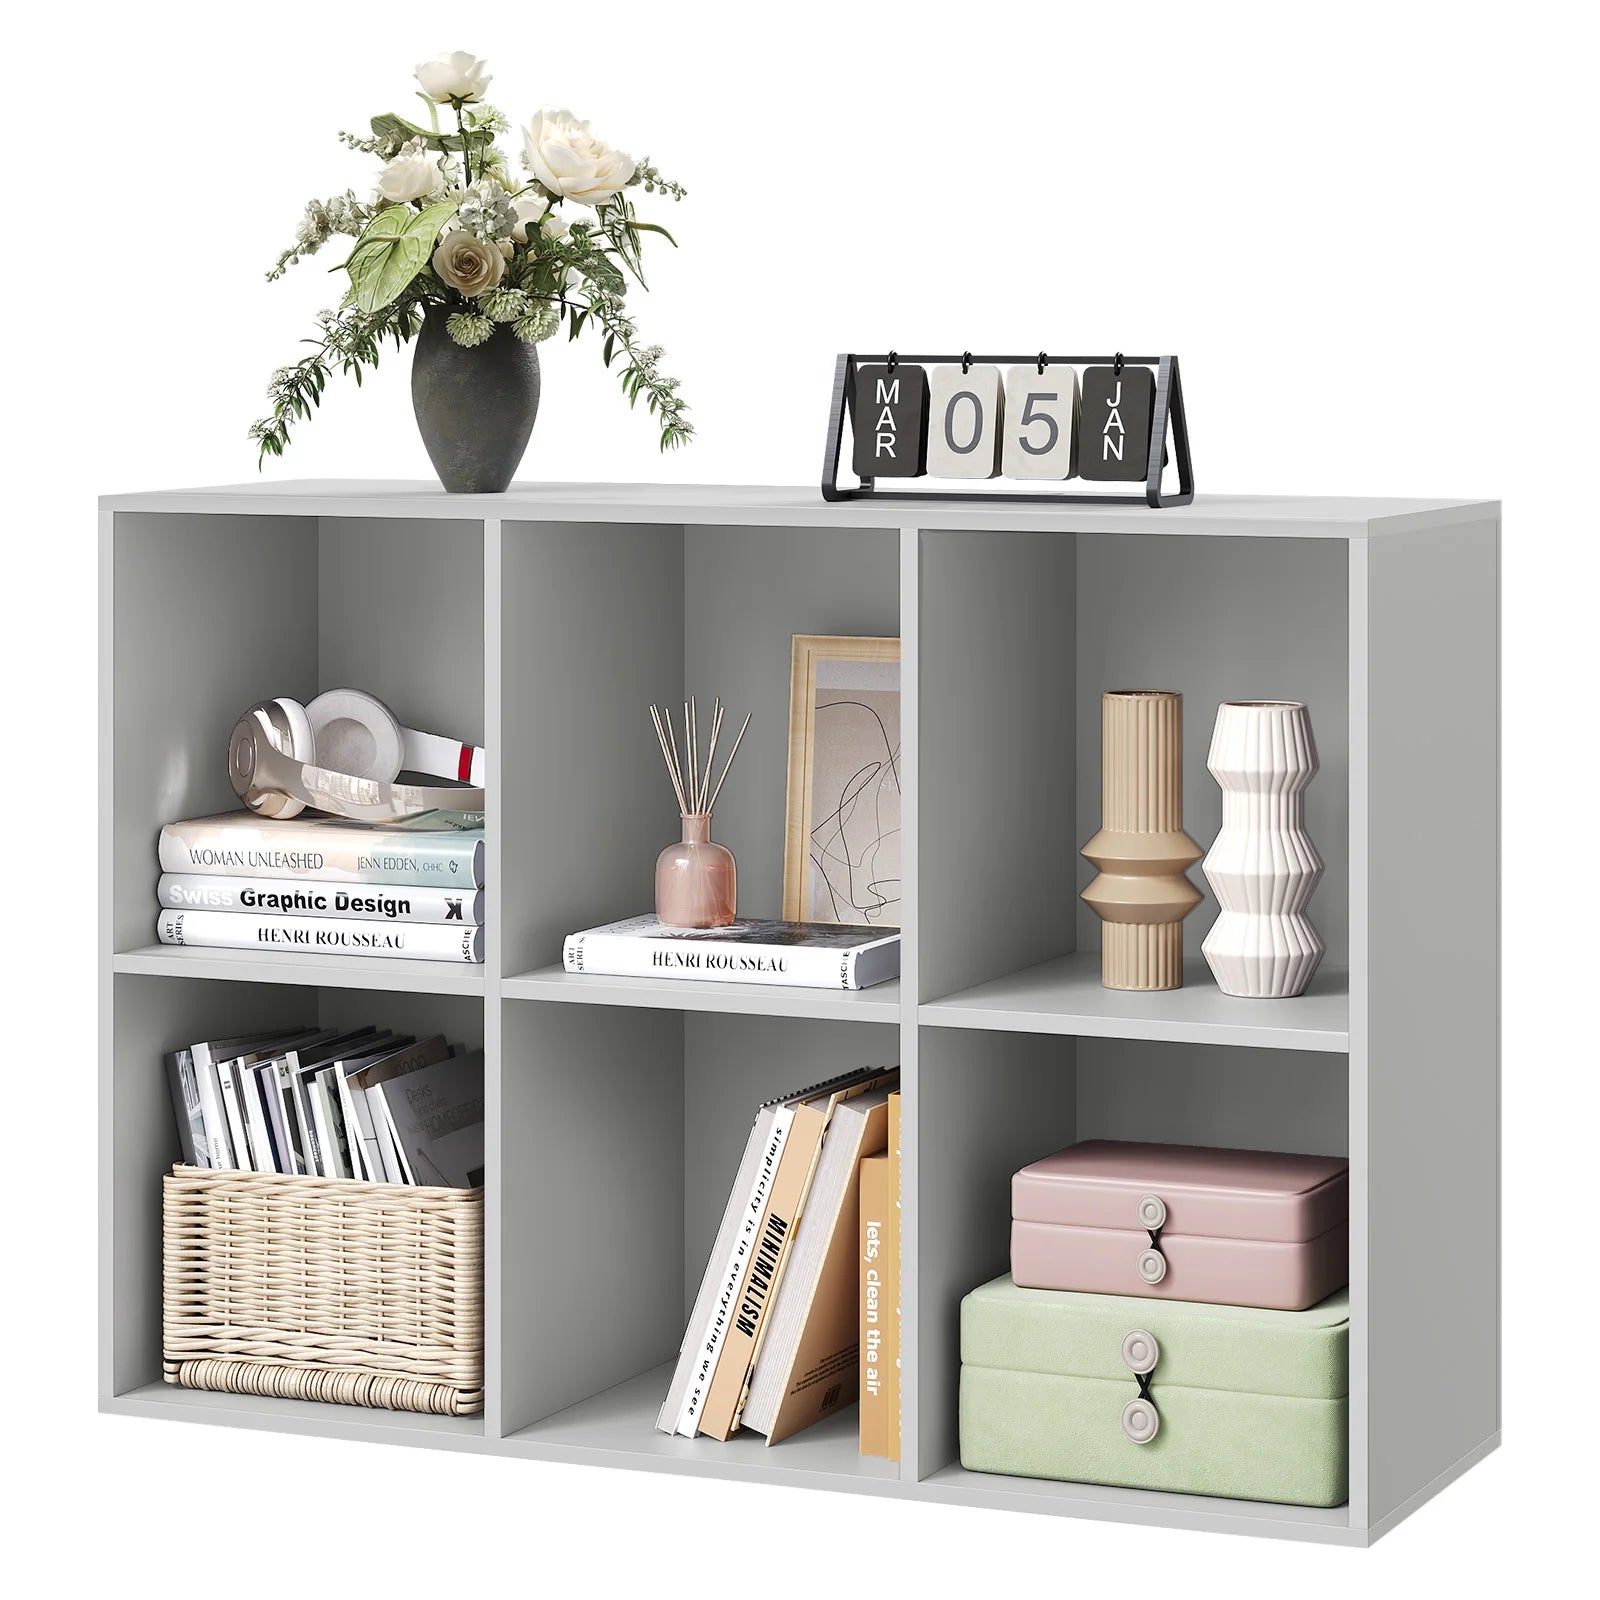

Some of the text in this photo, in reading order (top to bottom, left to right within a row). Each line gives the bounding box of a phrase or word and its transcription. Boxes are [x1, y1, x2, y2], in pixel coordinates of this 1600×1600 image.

[875, 378, 899, 458] MAR
[1018, 392, 1059, 456] 5
[1102, 381, 1125, 461] JAN
[189, 849, 324, 870] WOMAN UNLEASHED
[357, 856, 381, 871] JENN
[169, 884, 411, 918] Swiss Graphic Design
[166, 922, 175, 940] ART
[175, 914, 185, 946] SERIES
[258, 928, 405, 949] HENRI ROUSSEAU
[652, 951, 788, 972] HENRI ROUSSEAU
[688, 1127, 782, 1415] simplicity is in everything we see
[735, 1213, 788, 1338] MINIMALISM
[864, 1221, 881, 1396] lets, clean the air
